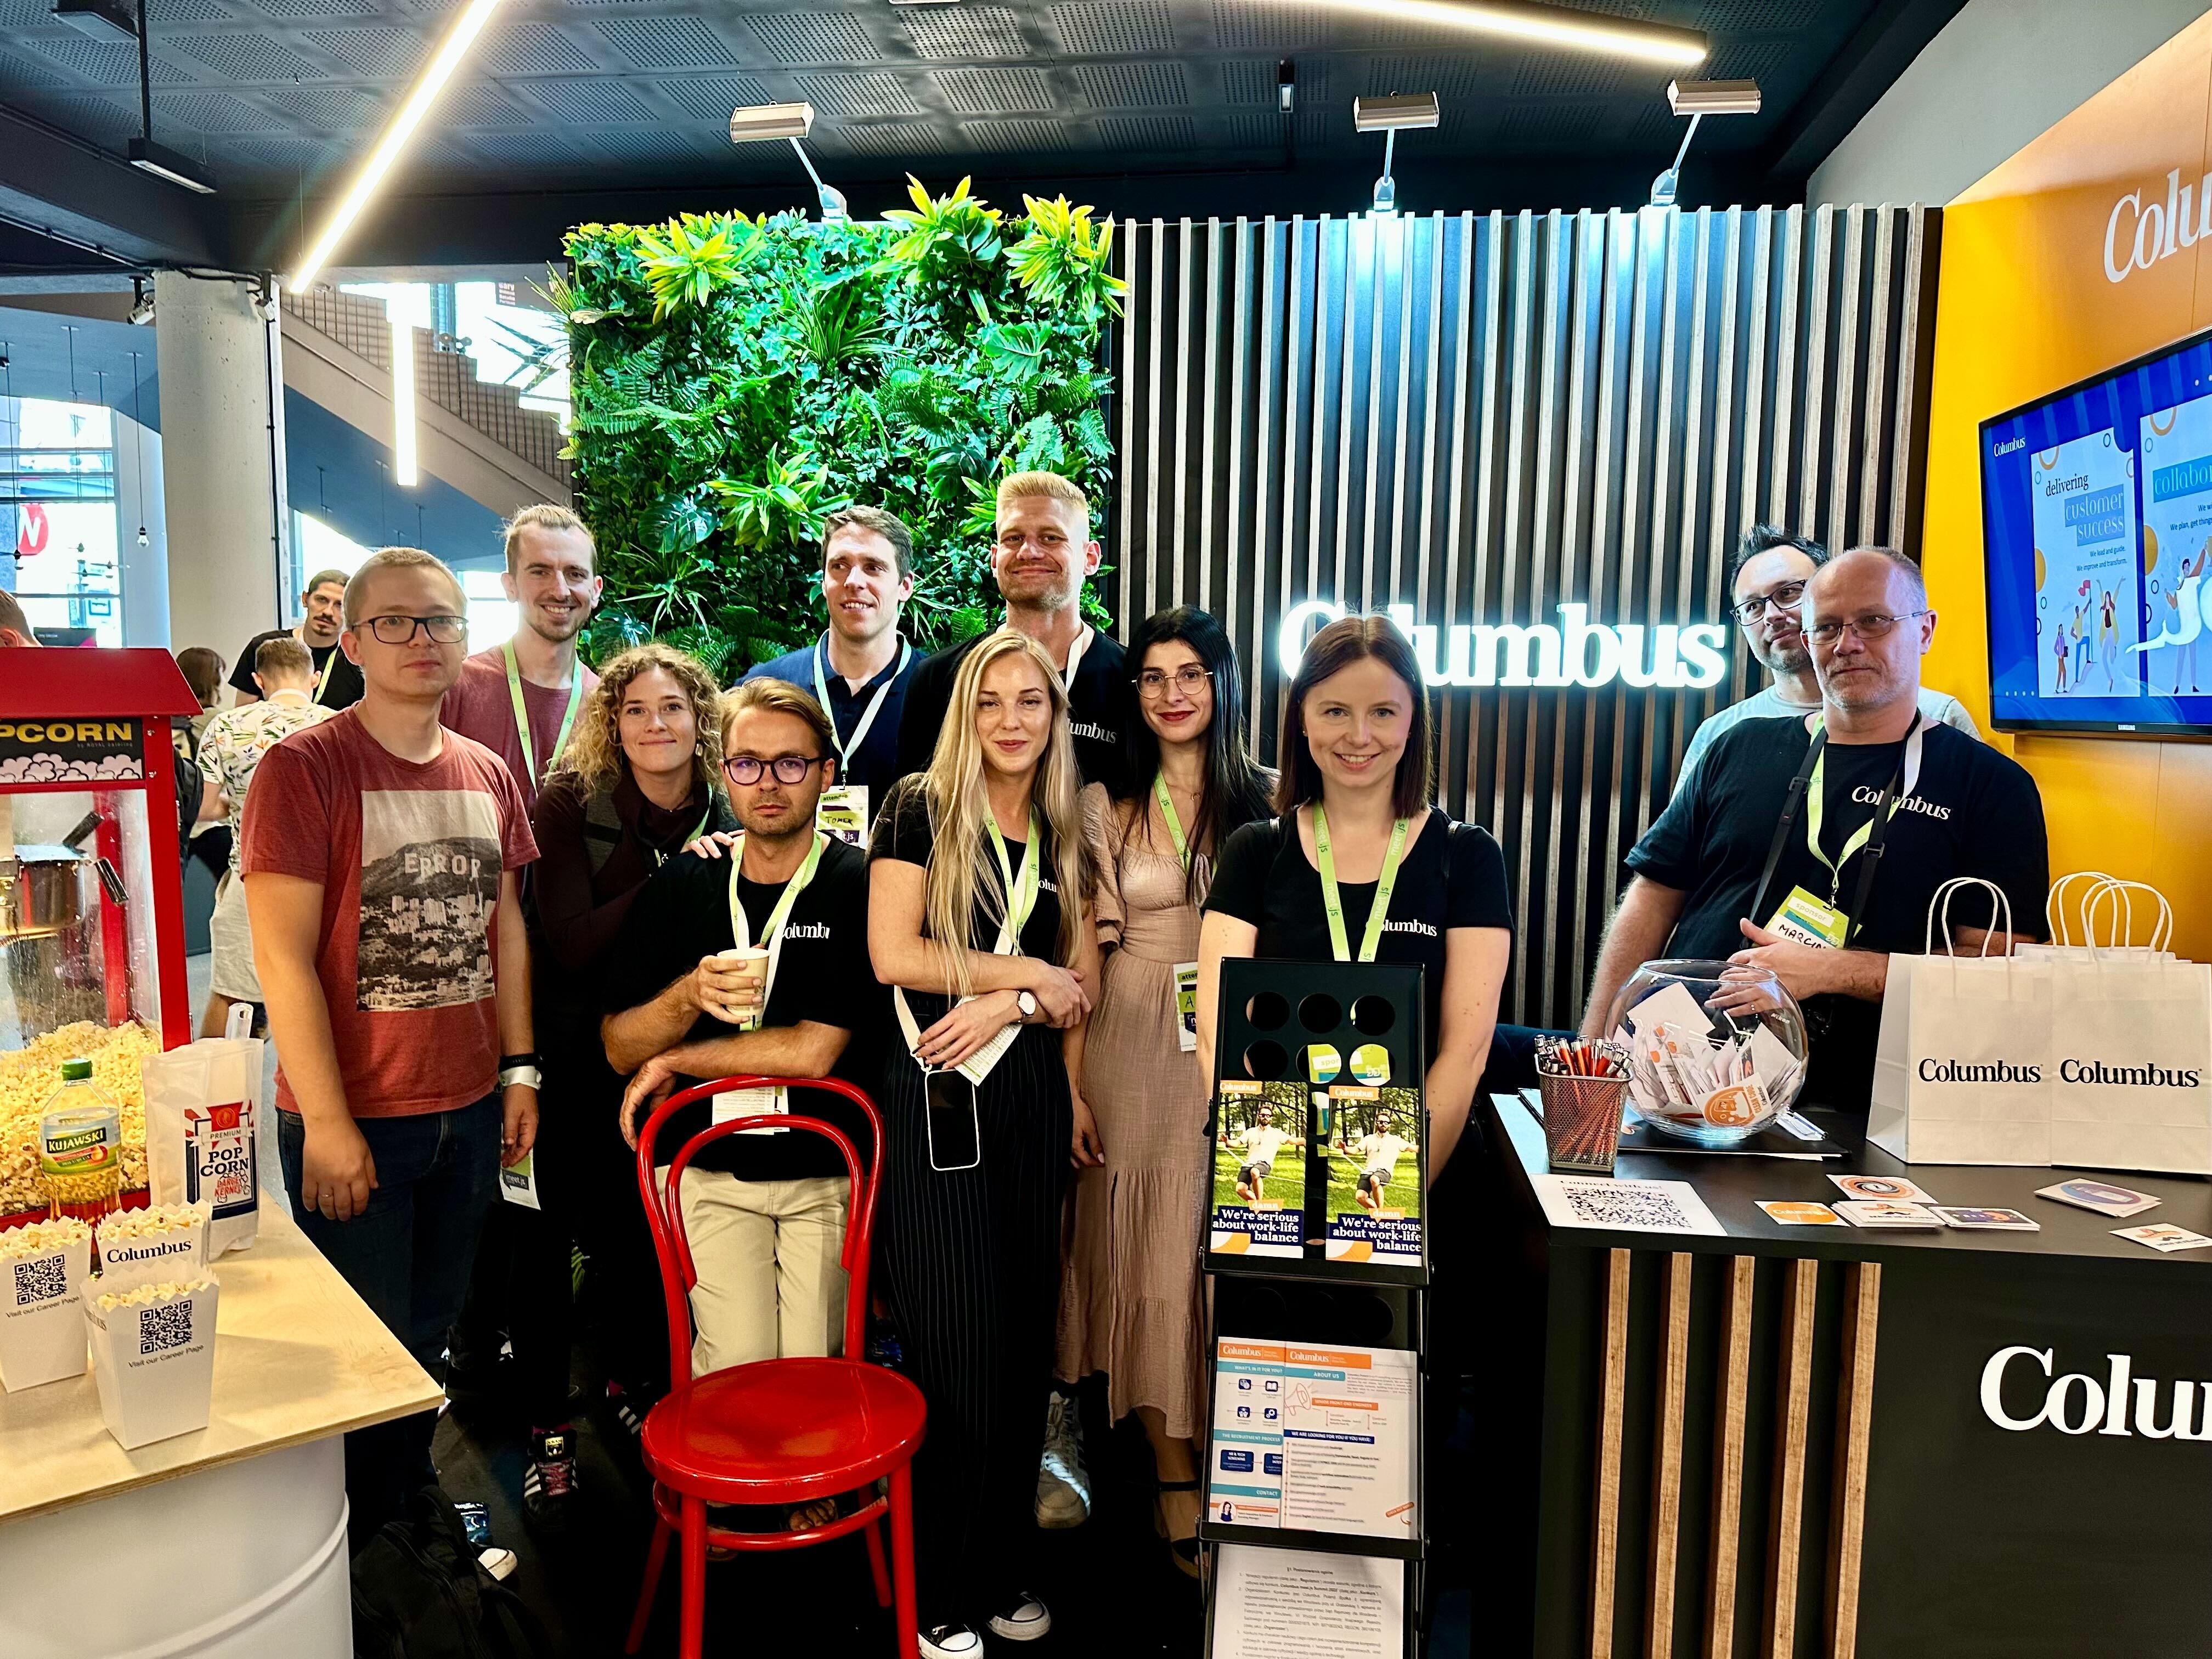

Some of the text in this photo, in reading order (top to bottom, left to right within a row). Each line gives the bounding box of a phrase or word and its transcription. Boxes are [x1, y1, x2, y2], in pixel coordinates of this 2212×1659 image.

[2104, 167, 2212, 283] Colu
[1994, 437, 2025, 456] Columbus
[2046, 473, 2089, 496] delivering
[2066, 492, 2123, 521] customer
[2078, 516, 2124, 540] success
[2084, 562, 2098, 571] improve
[1279, 601, 1726, 689] Clumbus
[1068, 718, 1117, 743] umbus
[1316, 820, 1330, 853] meet.js
[1390, 822, 1406, 856] meet.js
[405, 853, 481, 879] ERROR
[1326, 883, 1339, 916] meet.js
[1373, 887, 1390, 919] meet.js
[1796, 902, 1826, 921] sponsor
[783, 922, 830, 939] olumb
[1383, 918, 1437, 936] lumbus
[1918, 1058, 2041, 1083] Columbus
[2059, 1059, 2199, 1088] Columbus
[1219, 1082, 1257, 1092] Columbus
[1334, 1088, 1374, 1098] Columbus
[48, 1130, 104, 1152] KUJAWSKI
[210, 1129, 241, 1139] PREMIUM
[208, 1147, 242, 1163] POP
[200, 1158, 249, 1177] CORN
[1251, 1201, 1278, 1210] damn
[1372, 1210, 1401, 1218] damn
[1222, 1209, 1300, 1222] We're serious
[1341, 1217, 1422, 1232] We're serious
[1212, 1218, 1300, 1233] about work-life
[1333, 1227, 1422, 1242] about work-life
[1254, 1230, 1299, 1243] balance
[1376, 1239, 1422, 1252] balance
[107, 1240, 192, 1263] Columbus
[6, 1310, 22, 1318] Visit
[36, 1301, 60, 1312] Career
[61, 1295, 80, 1307] Page
[128, 1358, 145, 1369] Visit
[159, 1350, 185, 1362] Career
[185, 1344, 204, 1356] Page
[1222, 1345, 1262, 1357] Columbus
[1290, 1351, 1330, 1363] Columbus
[1980, 1346, 2212, 1441] Colu
